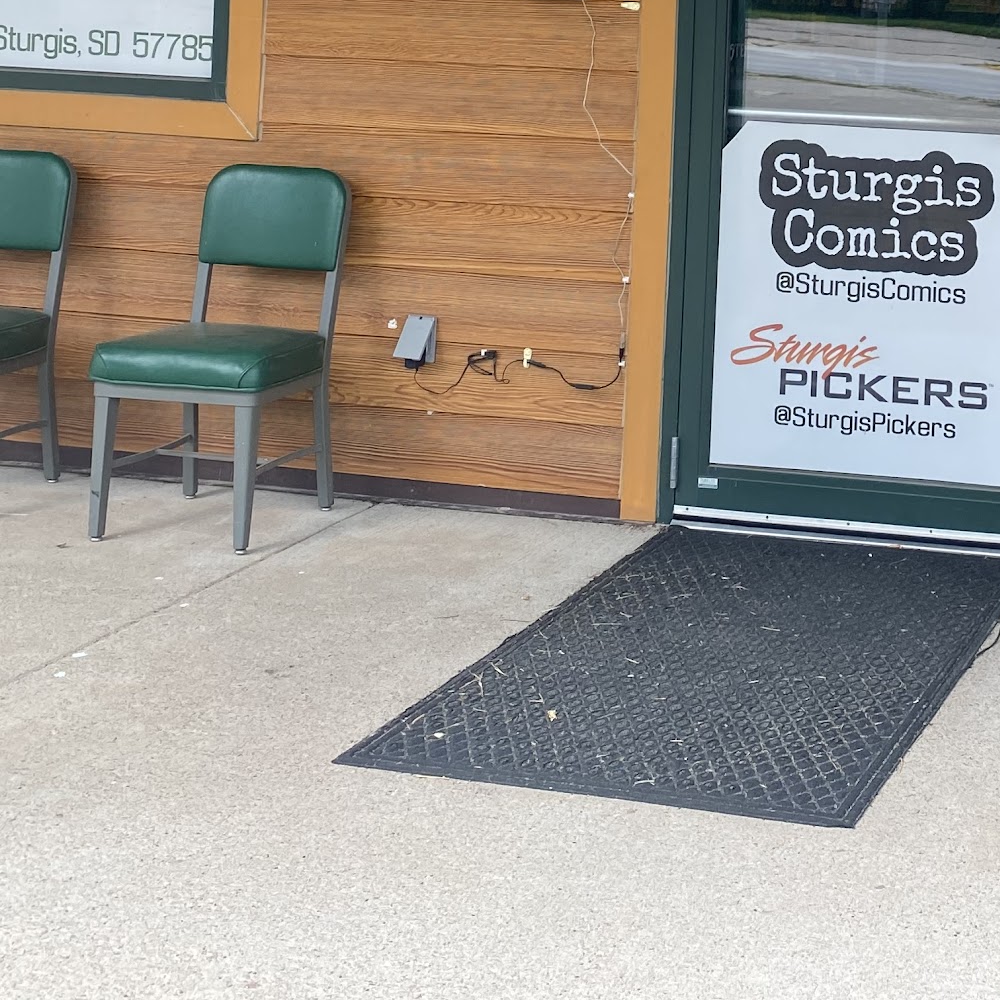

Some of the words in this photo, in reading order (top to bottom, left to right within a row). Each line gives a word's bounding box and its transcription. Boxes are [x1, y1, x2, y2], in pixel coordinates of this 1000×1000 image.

[88, 29, 120, 56] SD
[132, 31, 214, 62] 57785
[772, 152, 982, 216] Sturgis
[783, 208, 965, 263] Comics
[775, 271, 967, 305] @SturgisComics
[730, 323, 880, 380] Sturgis
[779, 368, 989, 411] PICKERS
[774, 405, 957, 439] @SturgisPickers
